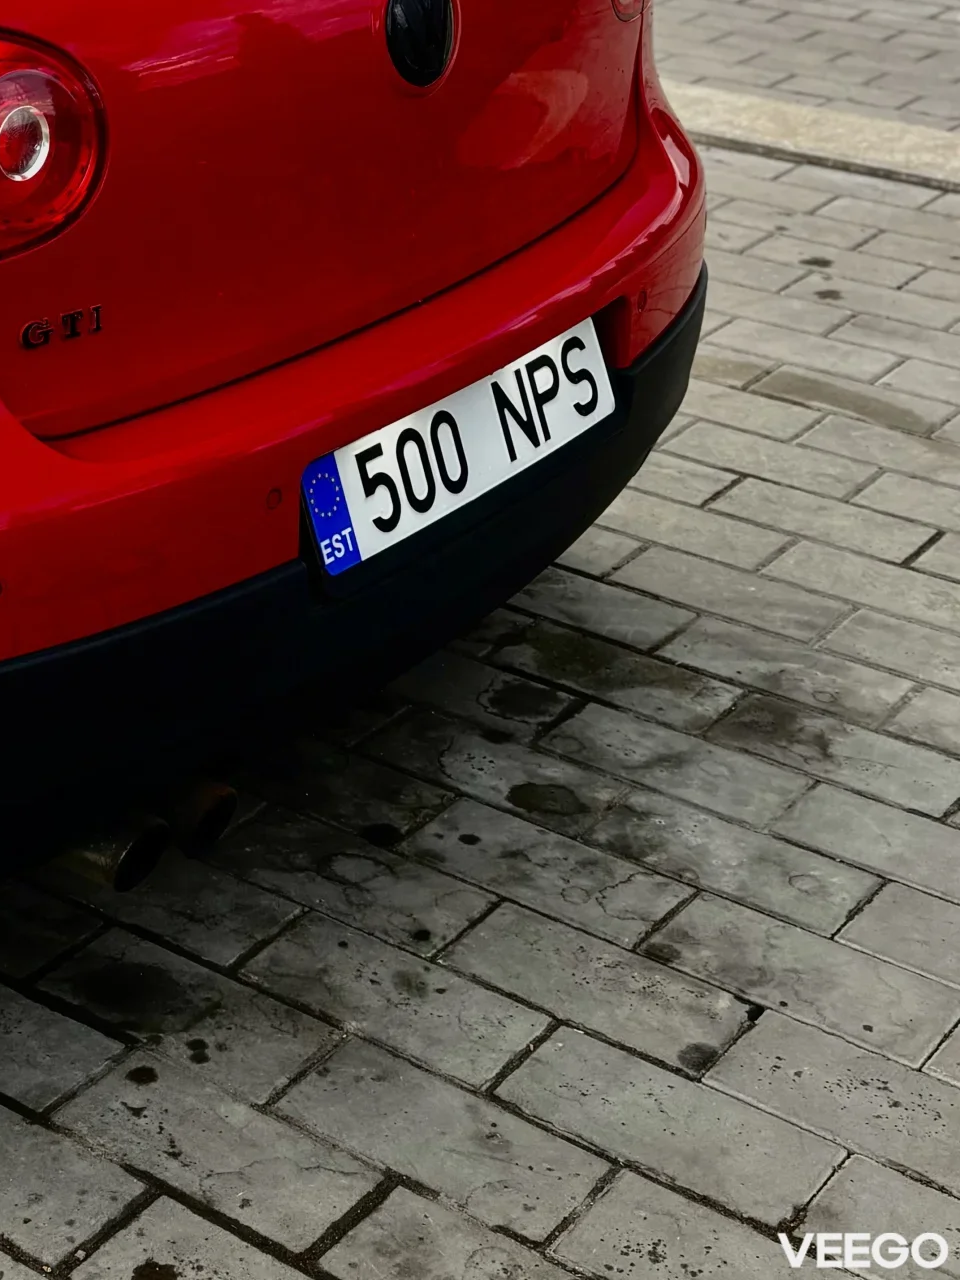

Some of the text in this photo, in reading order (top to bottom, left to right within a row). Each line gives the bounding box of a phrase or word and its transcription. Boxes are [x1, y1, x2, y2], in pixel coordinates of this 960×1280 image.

[20, 304, 104, 349] GTI
[354, 335, 600, 533] 500 NPS
[320, 526, 355, 566] EST
